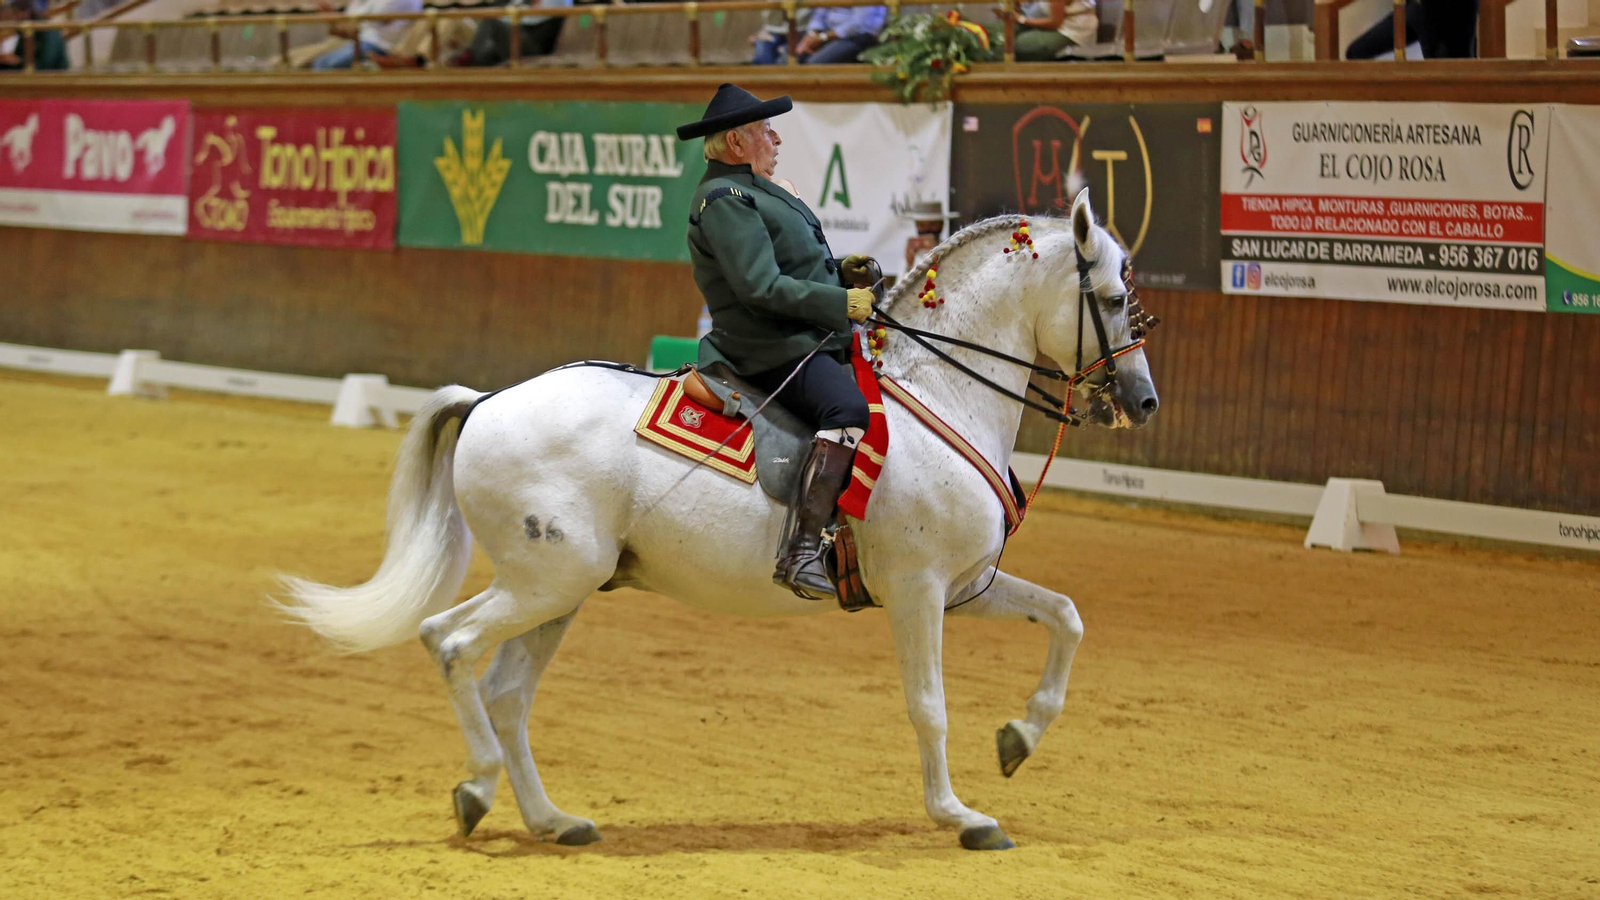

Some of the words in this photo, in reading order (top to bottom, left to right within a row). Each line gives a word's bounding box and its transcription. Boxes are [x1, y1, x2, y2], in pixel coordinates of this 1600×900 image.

[63, 113, 134, 182] Pavo
[1405, 123, 1482, 146] ARTESANA
[528, 130, 589, 177] CAJA
[592, 133, 684, 178] RURAL
[1319, 153, 1340, 179] EL
[1345, 153, 1393, 185] COJO
[1398, 154, 1447, 182] ROSA
[545, 181, 599, 225] DEL
[605, 183, 662, 229] SUR
[1241, 196, 1280, 212] TIENDA
[1318, 198, 1384, 215] MONTURAS
[1270, 214, 1299, 230] TODO
[1315, 216, 1399, 234] RELACIONADO
[1402, 220, 1426, 235] CON
[1429, 222, 1443, 236] EL
[1445, 221, 1504, 238] CABALLO
[1232, 238, 1260, 257] SAN
[1263, 239, 1305, 259] LUCAR
[1307, 241, 1330, 260] DE
[1333, 241, 1424, 265] BARRAMEDA
[1439, 244, 1469, 268] 956
[1473, 247, 1503, 269] 367
[1508, 249, 1538, 271] 016
[1387, 275, 1537, 300] www.elcojorosa.com
